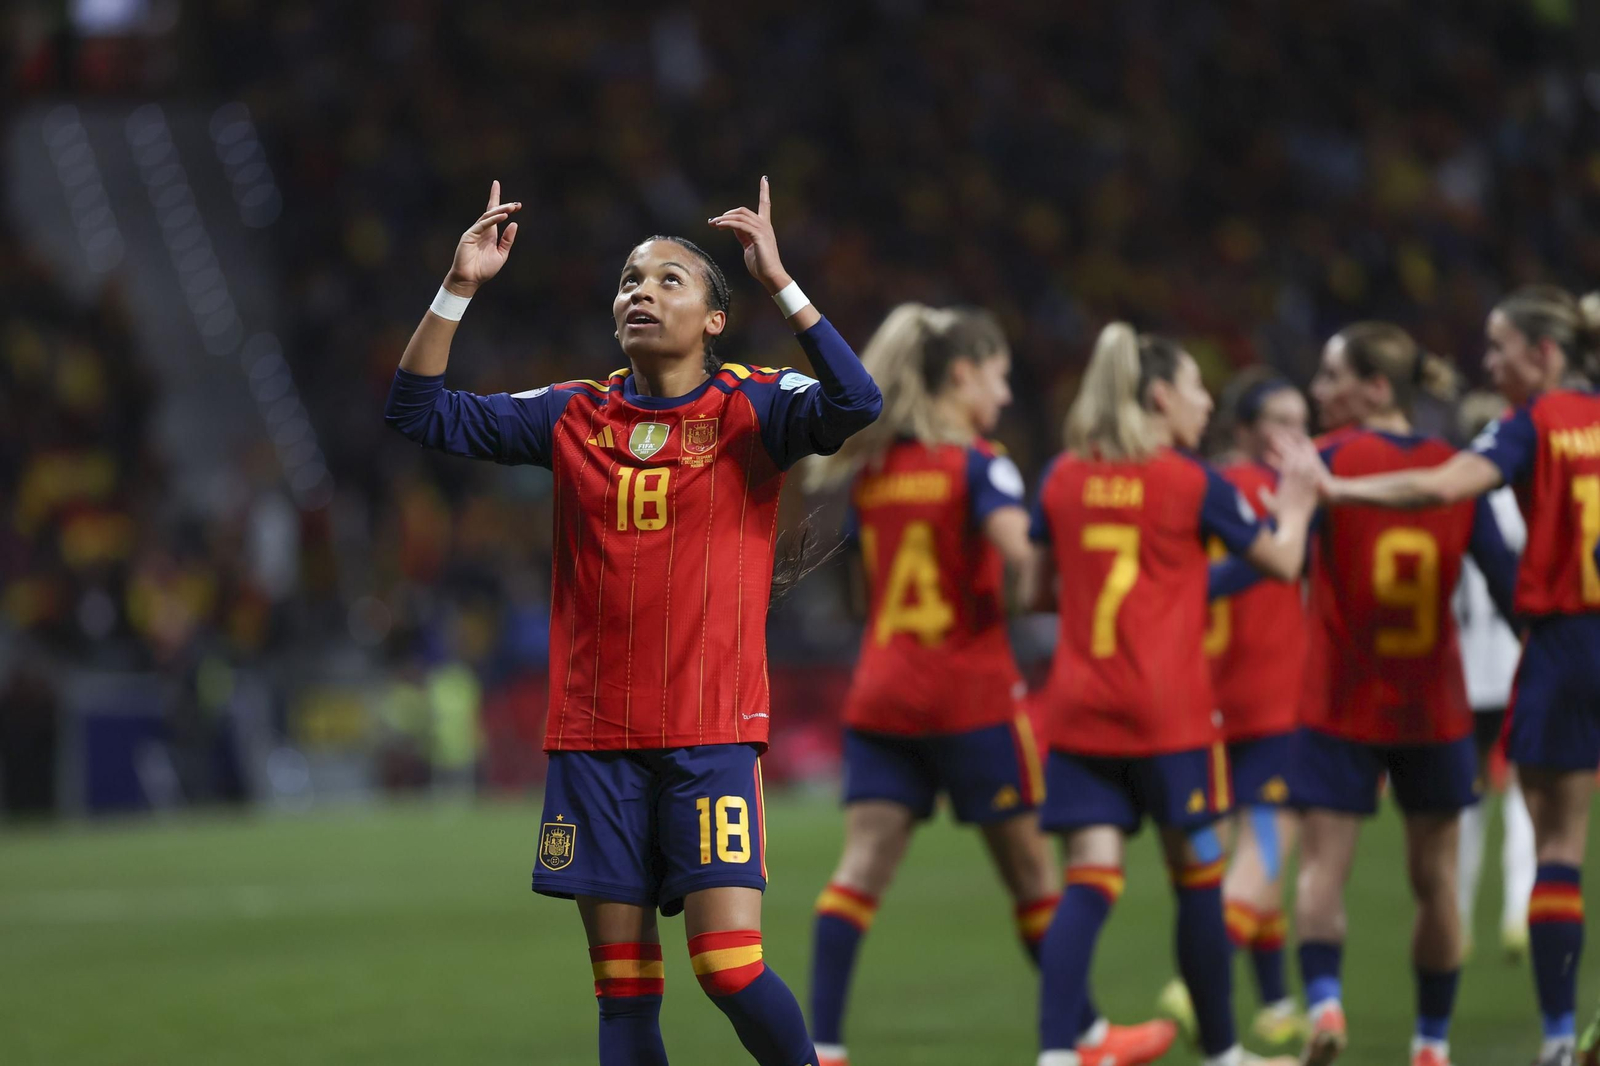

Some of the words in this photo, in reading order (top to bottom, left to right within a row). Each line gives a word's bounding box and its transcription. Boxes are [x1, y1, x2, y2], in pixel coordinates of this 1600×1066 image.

[617, 467, 670, 531] 18
[1081, 523, 1139, 659] 7
[1374, 527, 1439, 657] 9
[696, 795, 751, 865] 18
